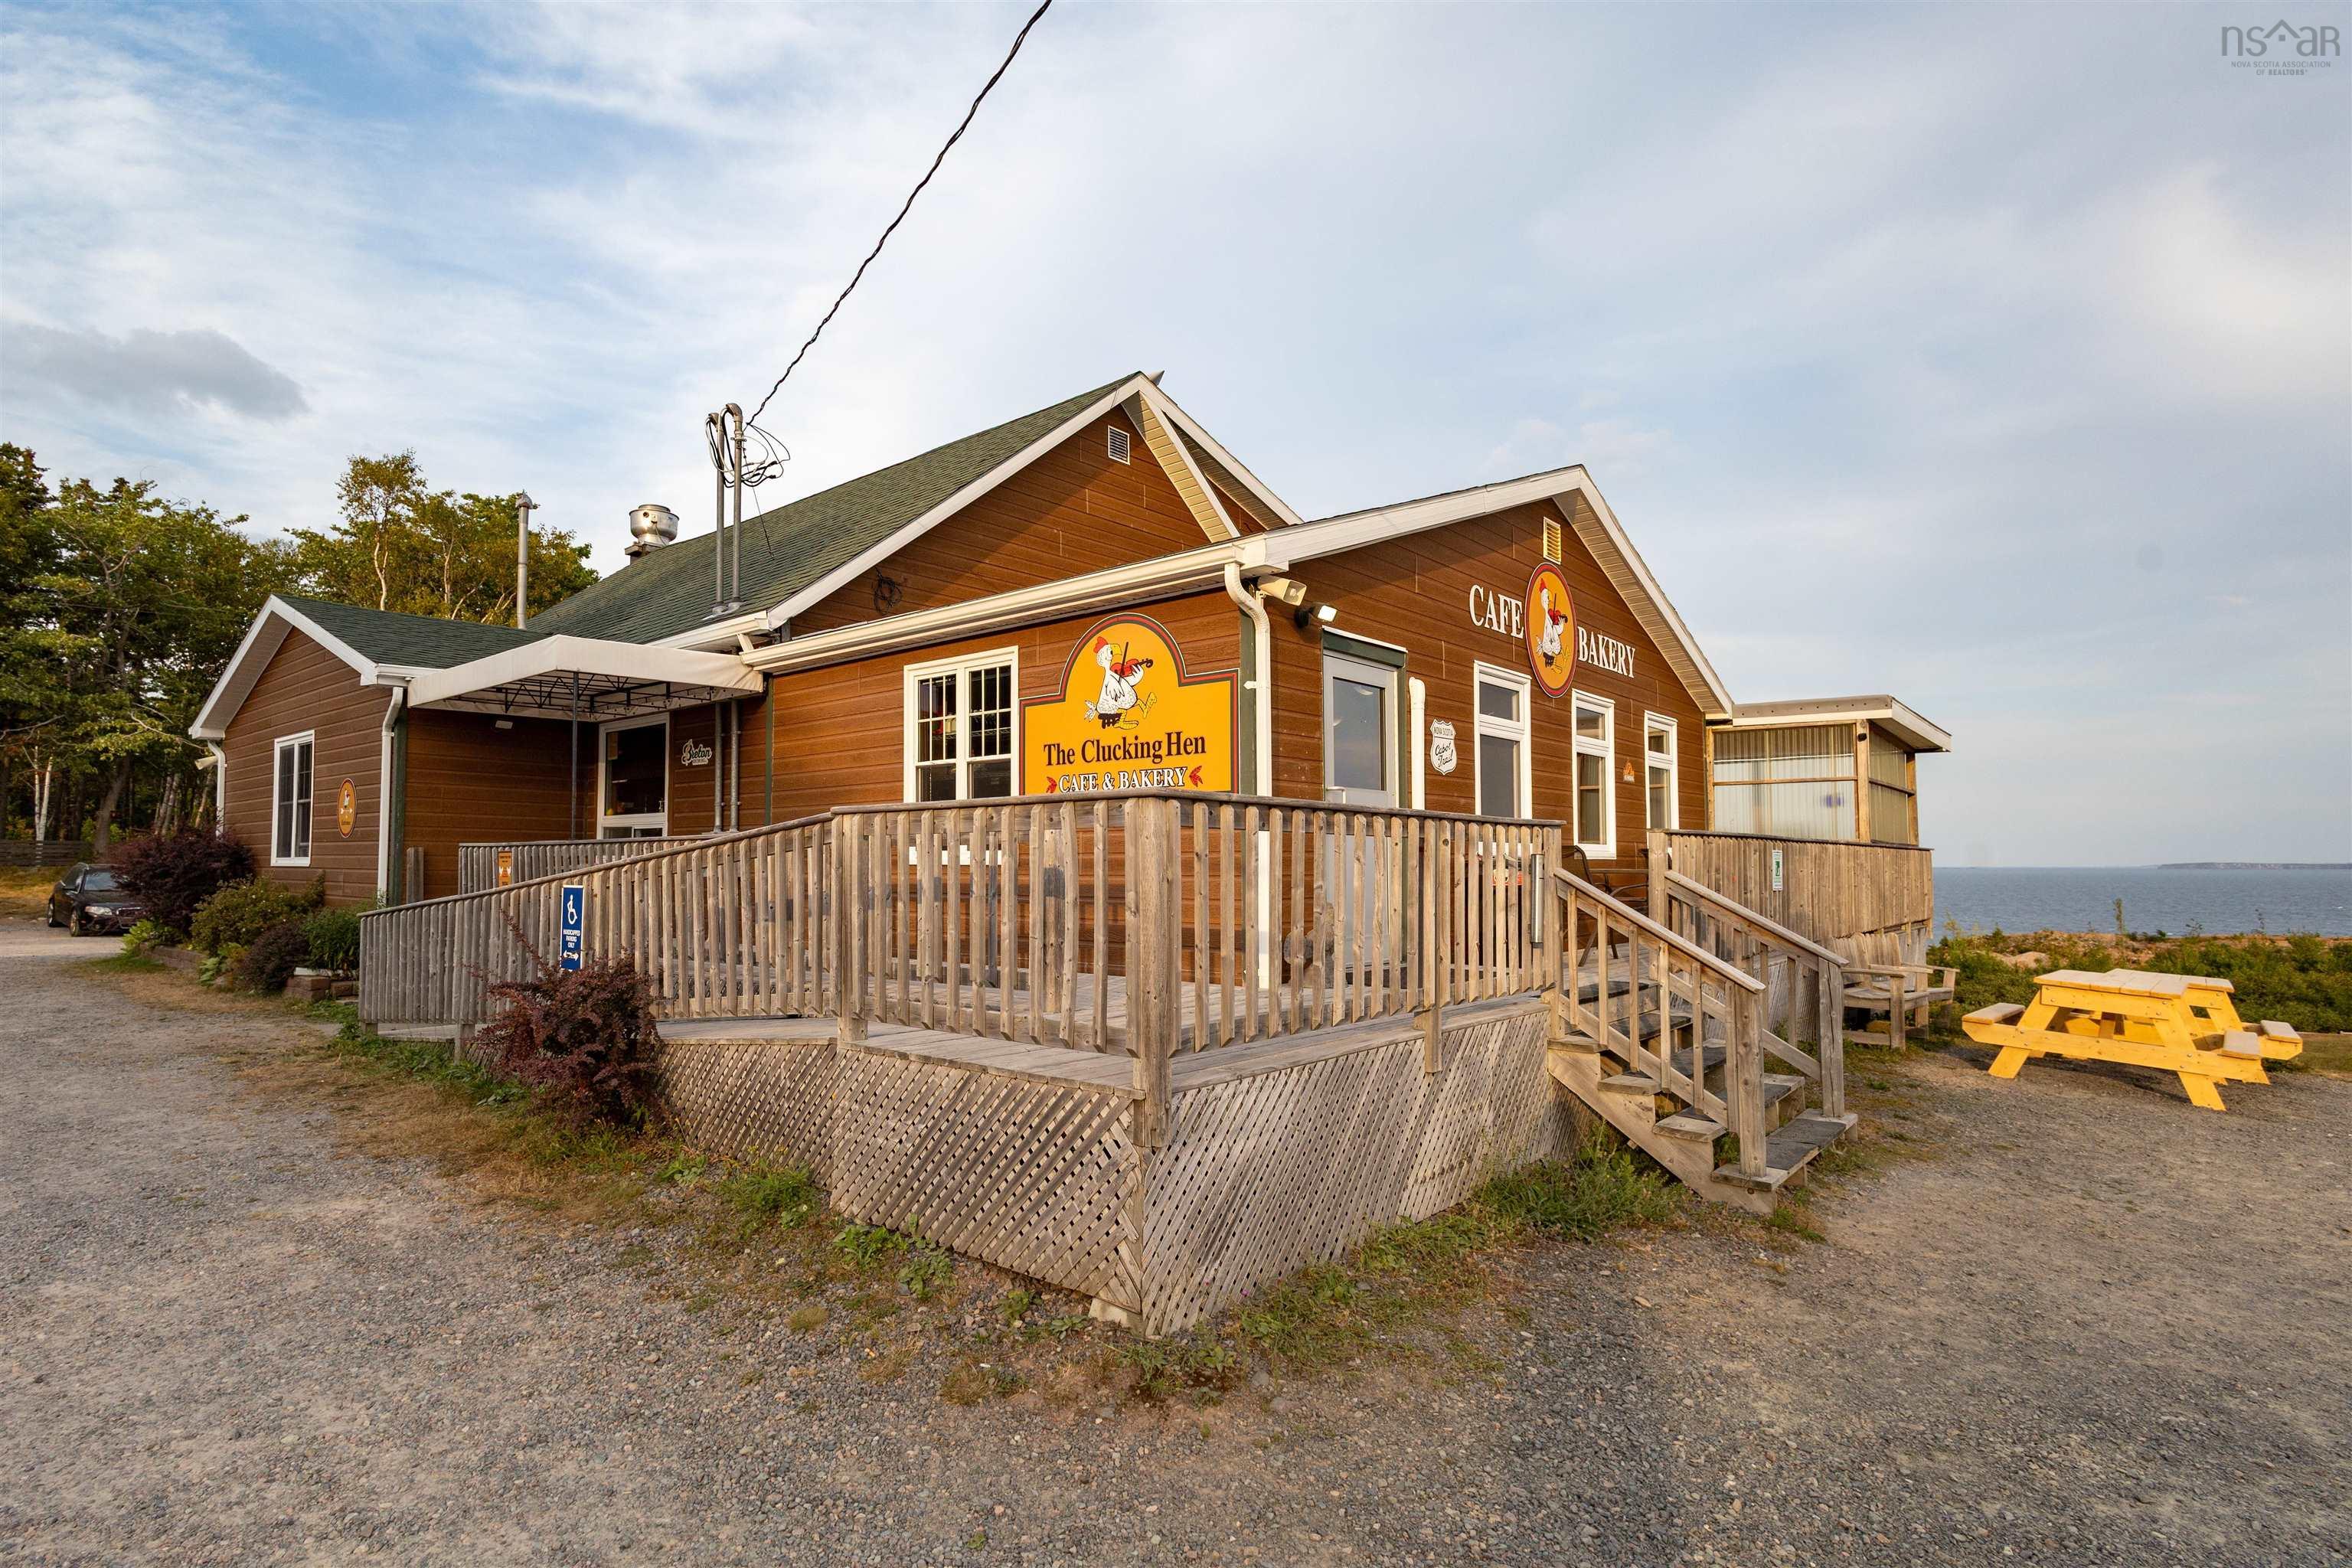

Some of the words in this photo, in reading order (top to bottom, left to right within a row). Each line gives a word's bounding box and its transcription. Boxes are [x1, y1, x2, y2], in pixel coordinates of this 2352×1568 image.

[1468, 584, 1524, 639] CAFE
[1577, 626, 1636, 678] BAKERY
[1044, 743, 1076, 766] The
[1081, 735, 1163, 764] Clucking
[1165, 730, 1207, 756] Hen
[1058, 772, 1099, 793] CAFE
[1102, 771, 1115, 791] &
[1118, 766, 1188, 789] BAKERY
